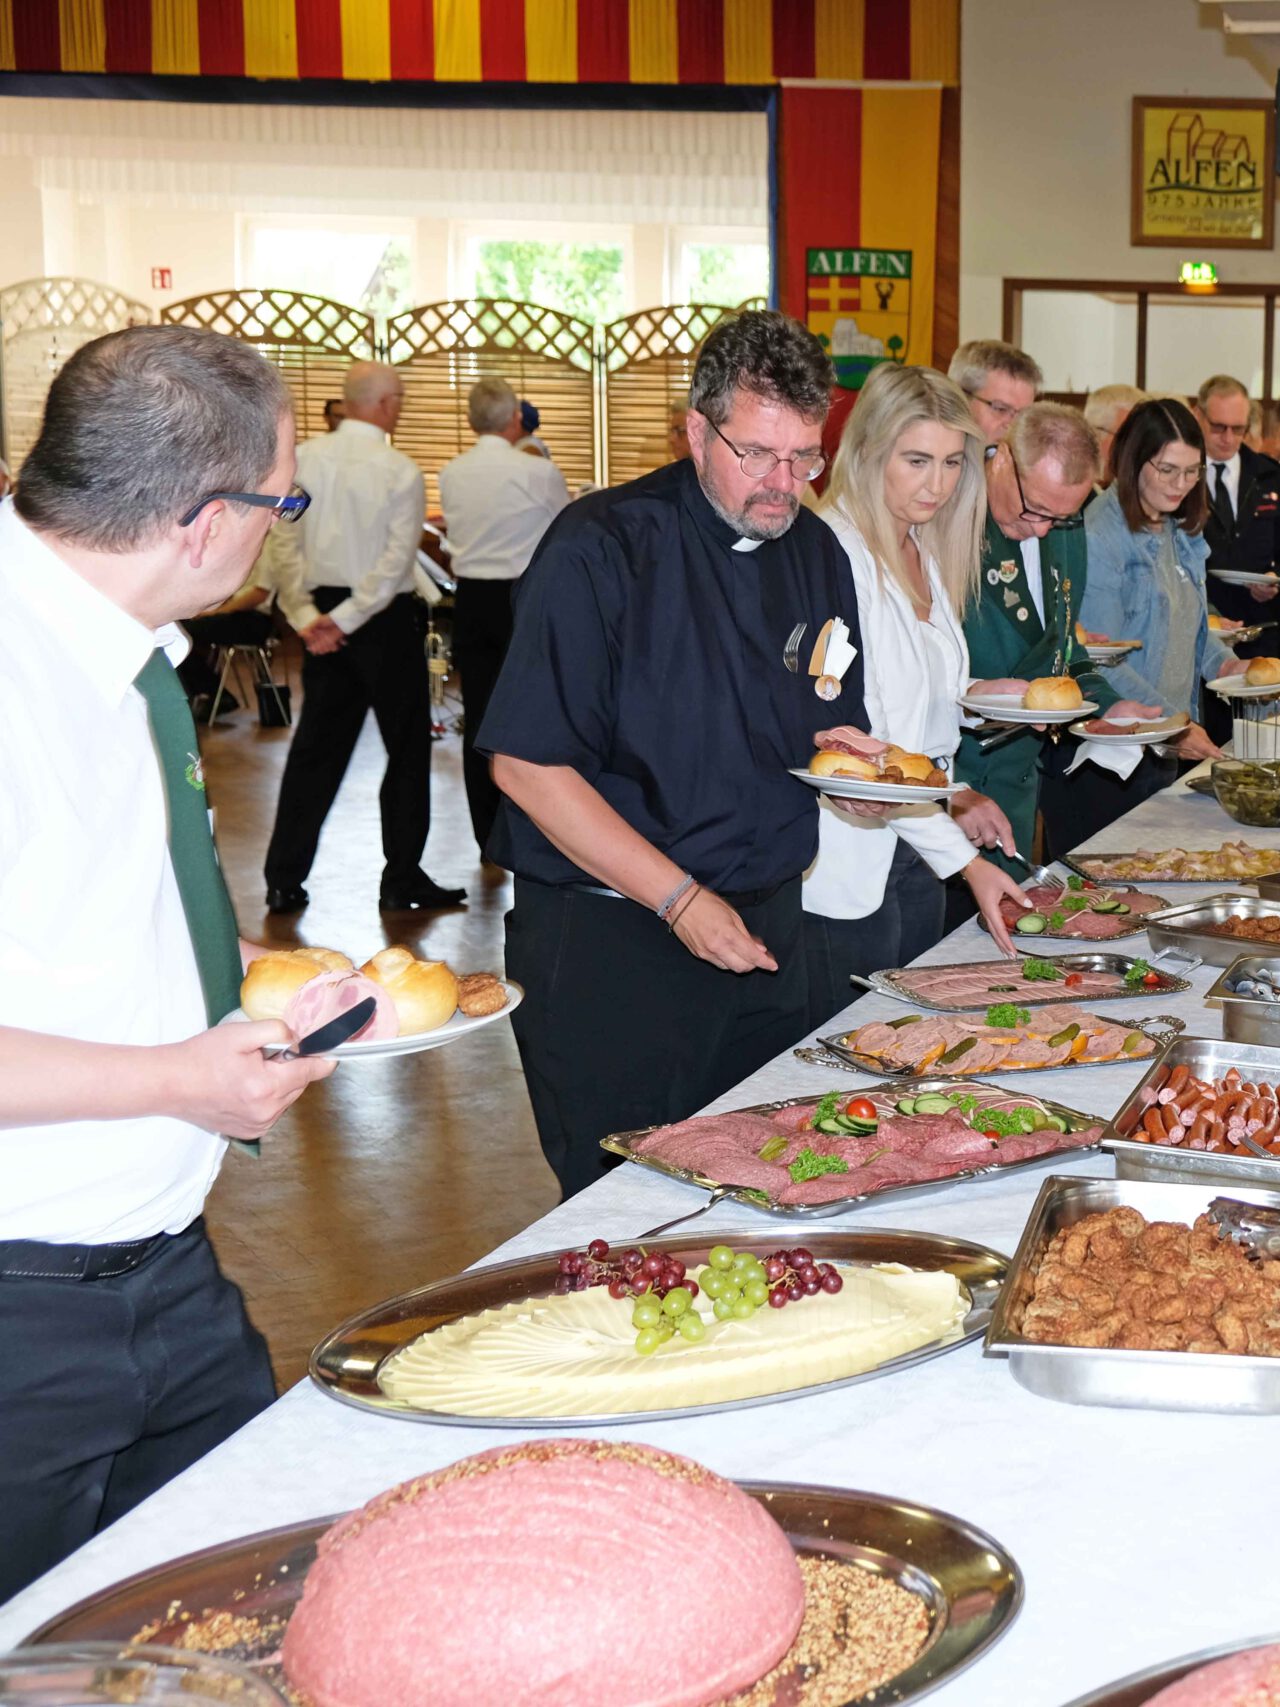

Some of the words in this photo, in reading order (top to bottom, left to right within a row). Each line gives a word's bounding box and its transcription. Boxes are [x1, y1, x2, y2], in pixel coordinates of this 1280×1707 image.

[1149, 158, 1256, 187] ALFEN
[1190, 195, 1257, 210] JAHRE
[811, 250, 908, 276] ALFEN
